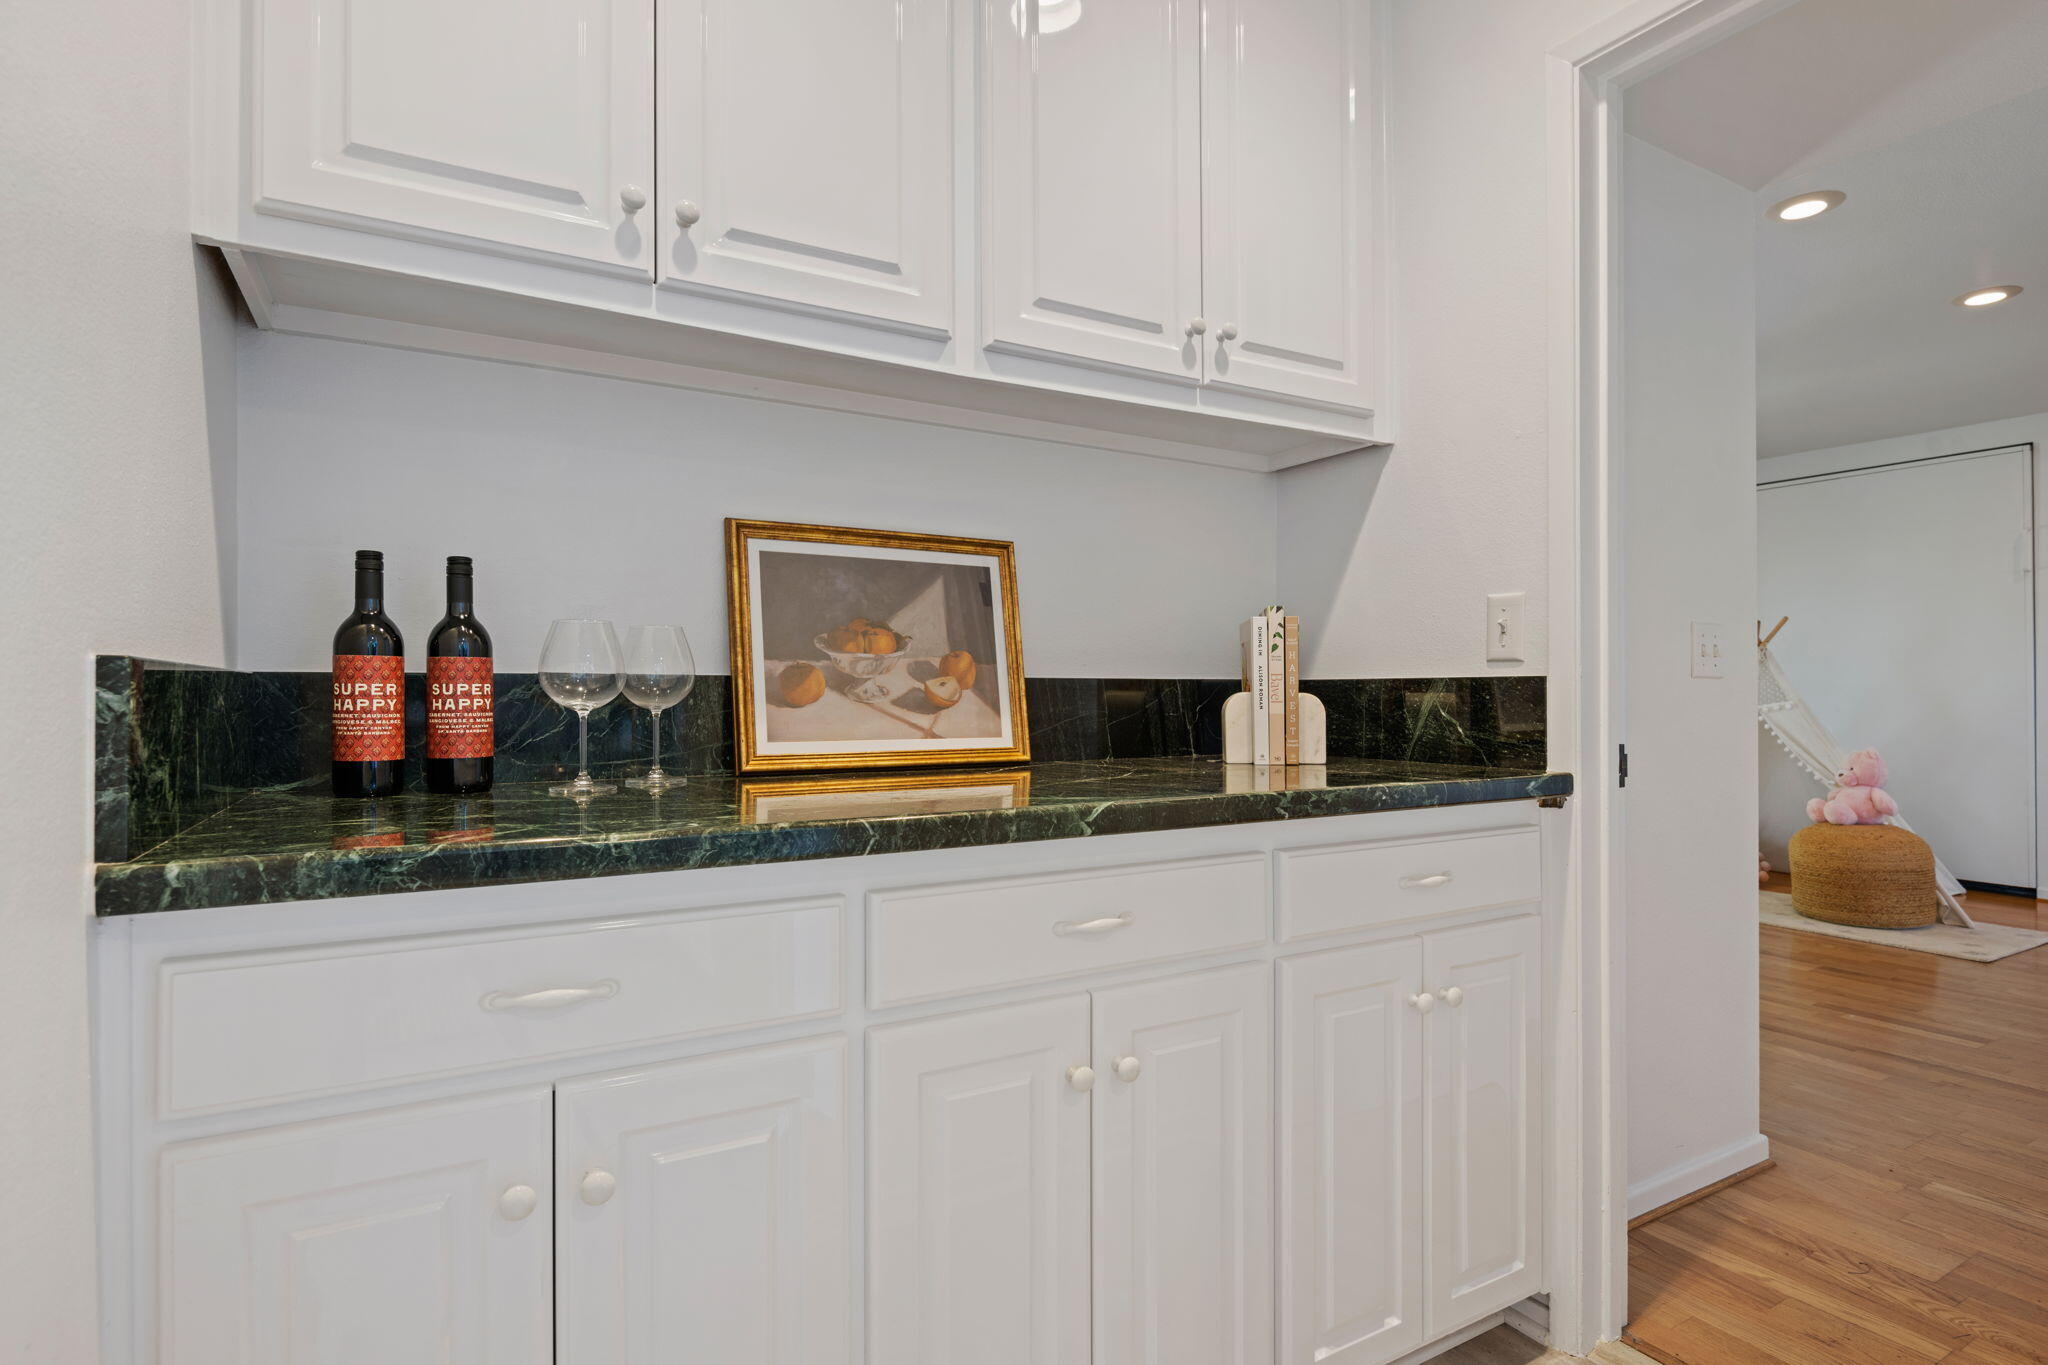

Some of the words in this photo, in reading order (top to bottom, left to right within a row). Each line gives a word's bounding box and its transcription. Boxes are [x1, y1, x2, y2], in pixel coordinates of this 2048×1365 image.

[333, 683, 397, 696] SUPER
[432, 683, 491, 695] SUPER
[1270, 673, 1283, 704] Bavel
[1289, 651, 1297, 736] HARVEST
[333, 699, 397, 711] HAPPY
[432, 698, 491, 710] HAPPY
